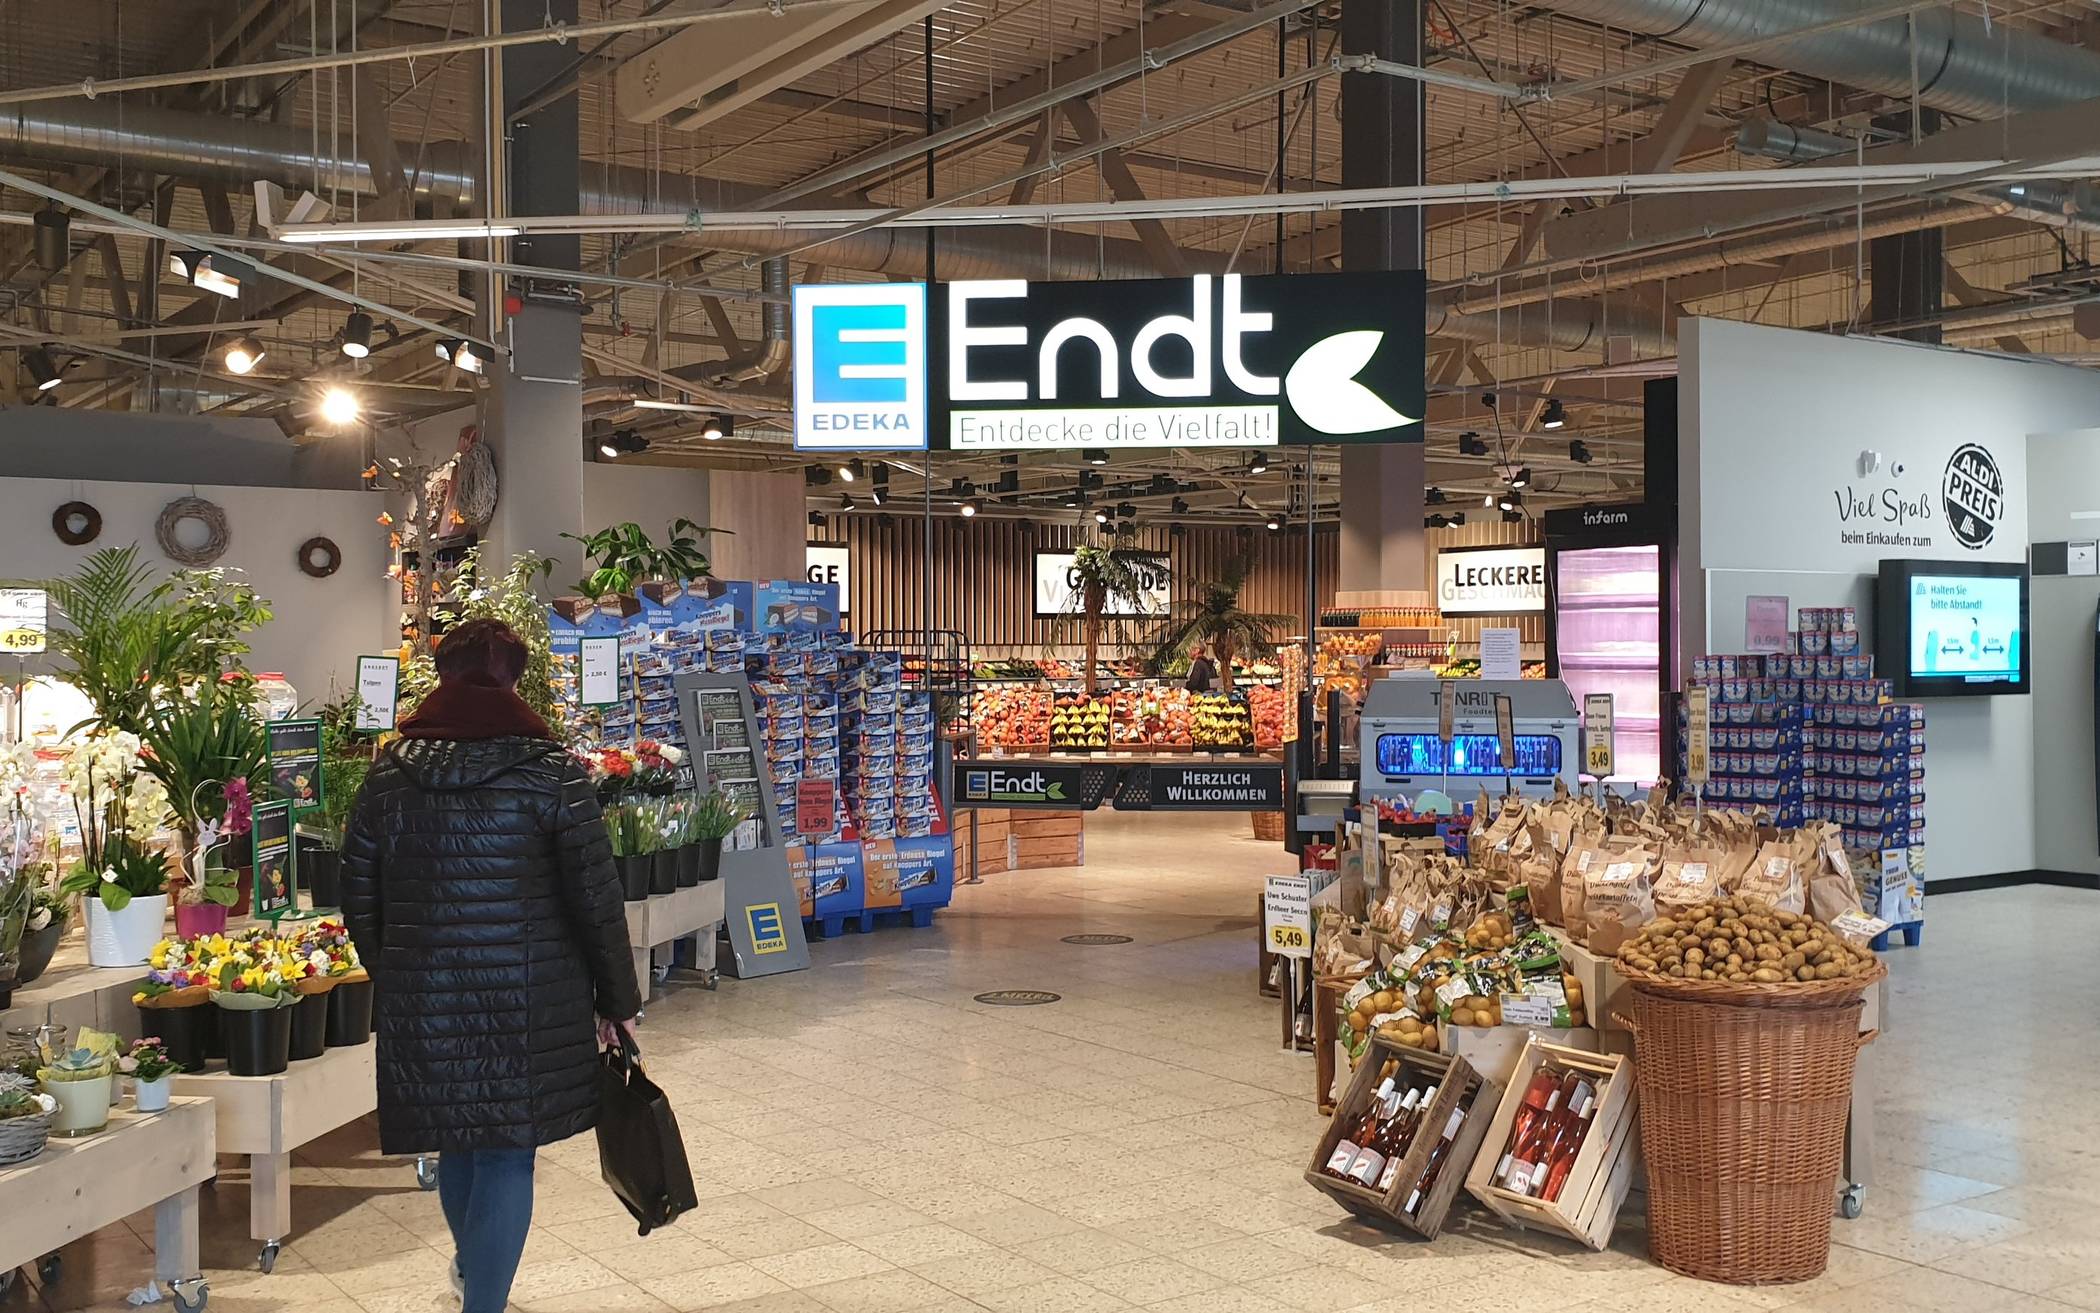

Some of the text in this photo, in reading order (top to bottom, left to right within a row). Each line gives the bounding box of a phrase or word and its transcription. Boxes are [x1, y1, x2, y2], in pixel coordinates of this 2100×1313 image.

[949, 273, 1280, 400] Endt
[812, 413, 910, 431] EDEKA
[960, 412, 1271, 443] Entdecke die Vielfalt!
[1960, 454, 1994, 489] ALDI
[1949, 472, 1997, 521] PREIS
[1834, 486, 1931, 526] Viel Spaß
[1583, 511, 1628, 526] infarm
[1841, 531, 1932, 546] beim Einkaufen zum
[1455, 563, 1545, 587] LECKERE
[1930, 585, 1967, 595] Halten Sie
[1930, 599, 1982, 609] bitte Abstand!
[5, 633, 38, 648] 4,99
[1430, 691, 1501, 706] TNRIT
[1463, 707, 1496, 715] Foodte
[1591, 752, 1609, 769] 3,49
[991, 770, 1046, 793] Endt
[1182, 771, 1250, 785] HERZLICH
[1167, 787, 1267, 801] WILLKOMMEN
[756, 940, 784, 950] EDEKA
[1275, 930, 1303, 947] 5,49
